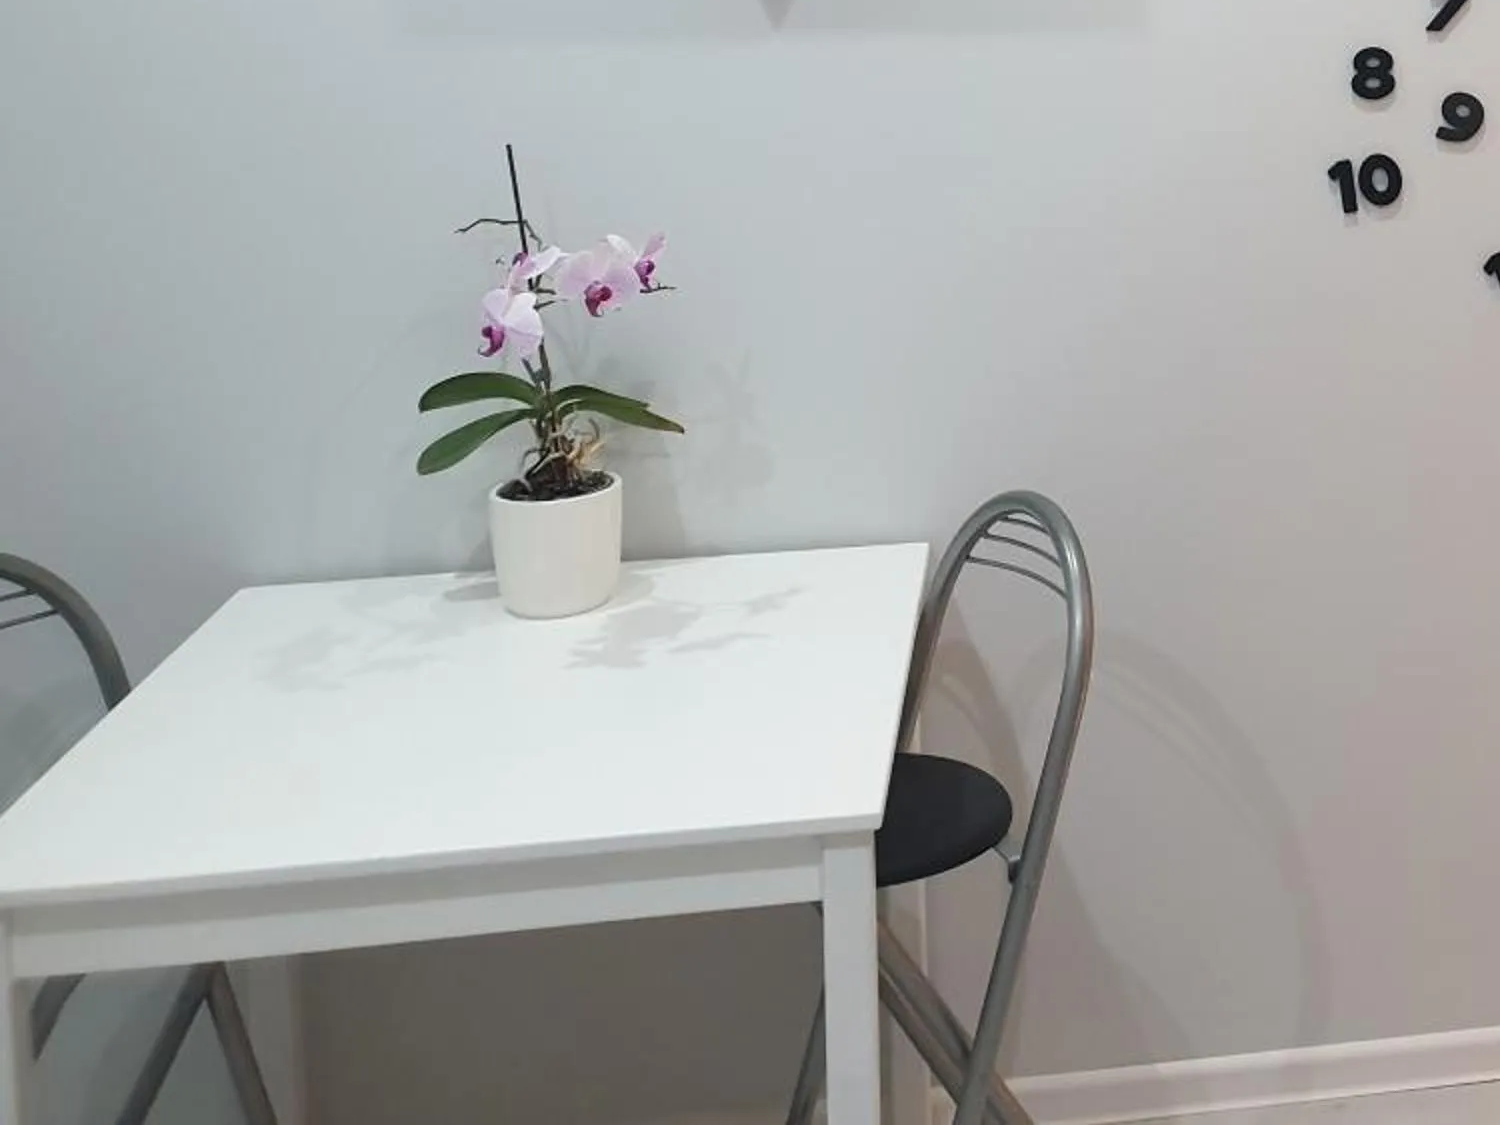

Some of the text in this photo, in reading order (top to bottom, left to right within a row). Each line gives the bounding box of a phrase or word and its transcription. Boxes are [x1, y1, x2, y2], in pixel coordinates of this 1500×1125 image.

[1351, 46, 1396, 101] 8
[1435, 92, 1485, 143] 9
[1327, 153, 1403, 214] 10
